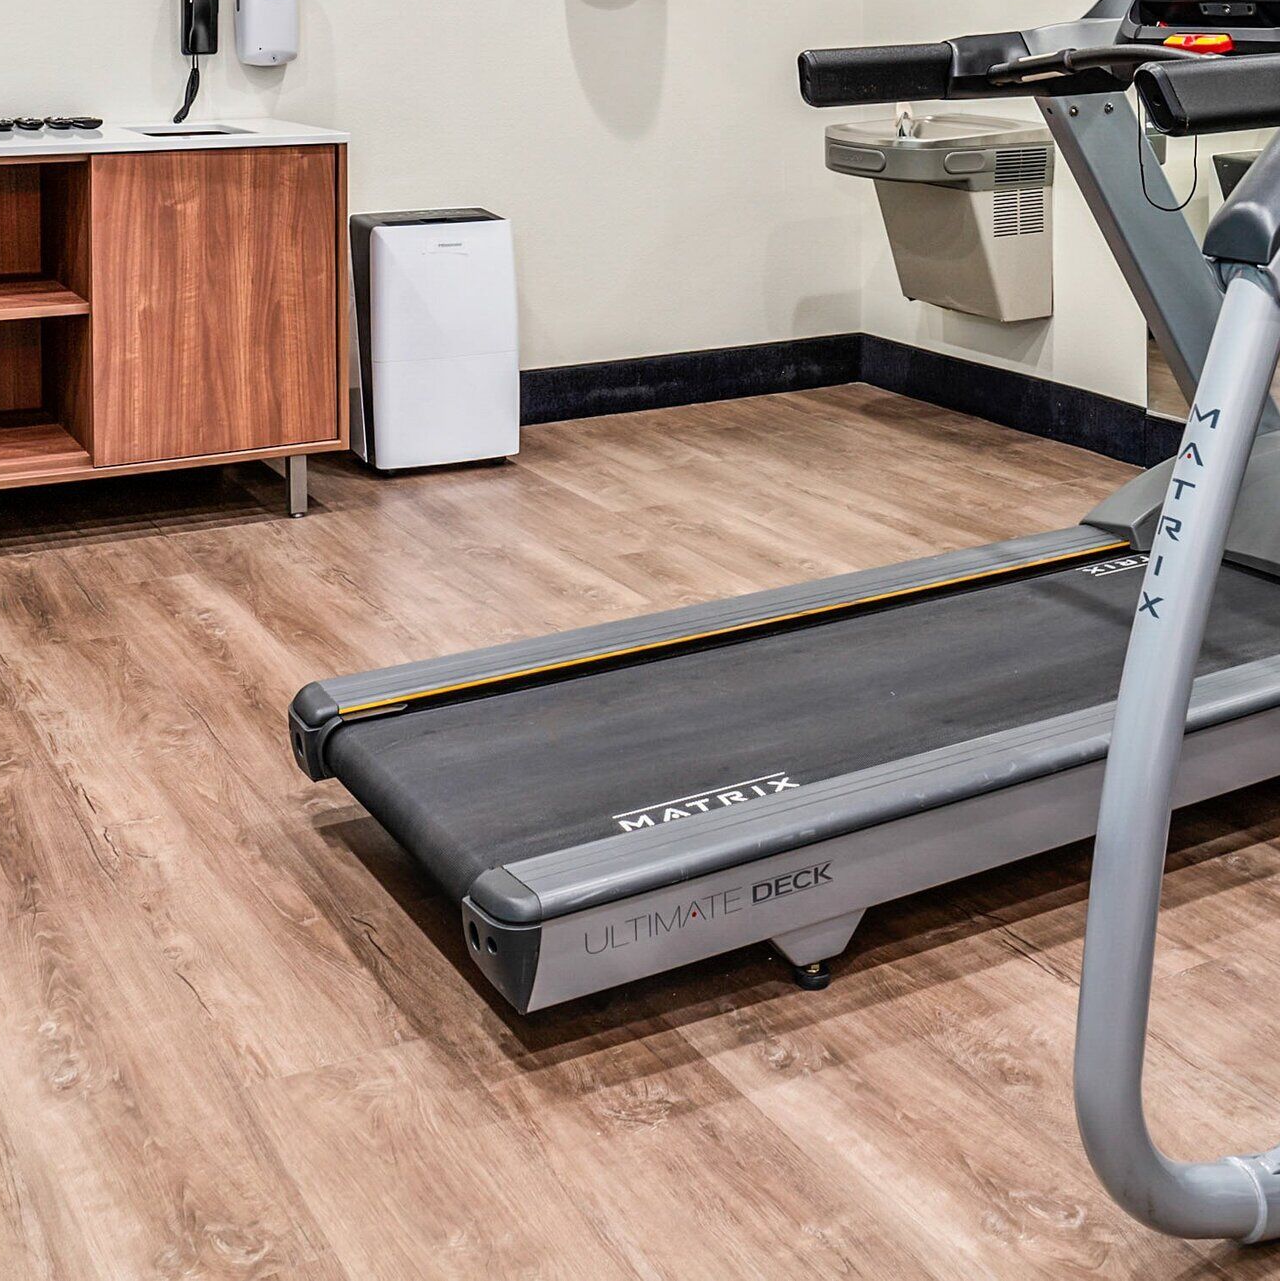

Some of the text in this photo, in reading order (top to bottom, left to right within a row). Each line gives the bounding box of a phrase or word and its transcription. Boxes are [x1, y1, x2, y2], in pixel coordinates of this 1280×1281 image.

[1138, 403, 1220, 619] MATRIX
[618, 777, 800, 832] MATRIX
[584, 860, 834, 955] ULTIMATE DECK
